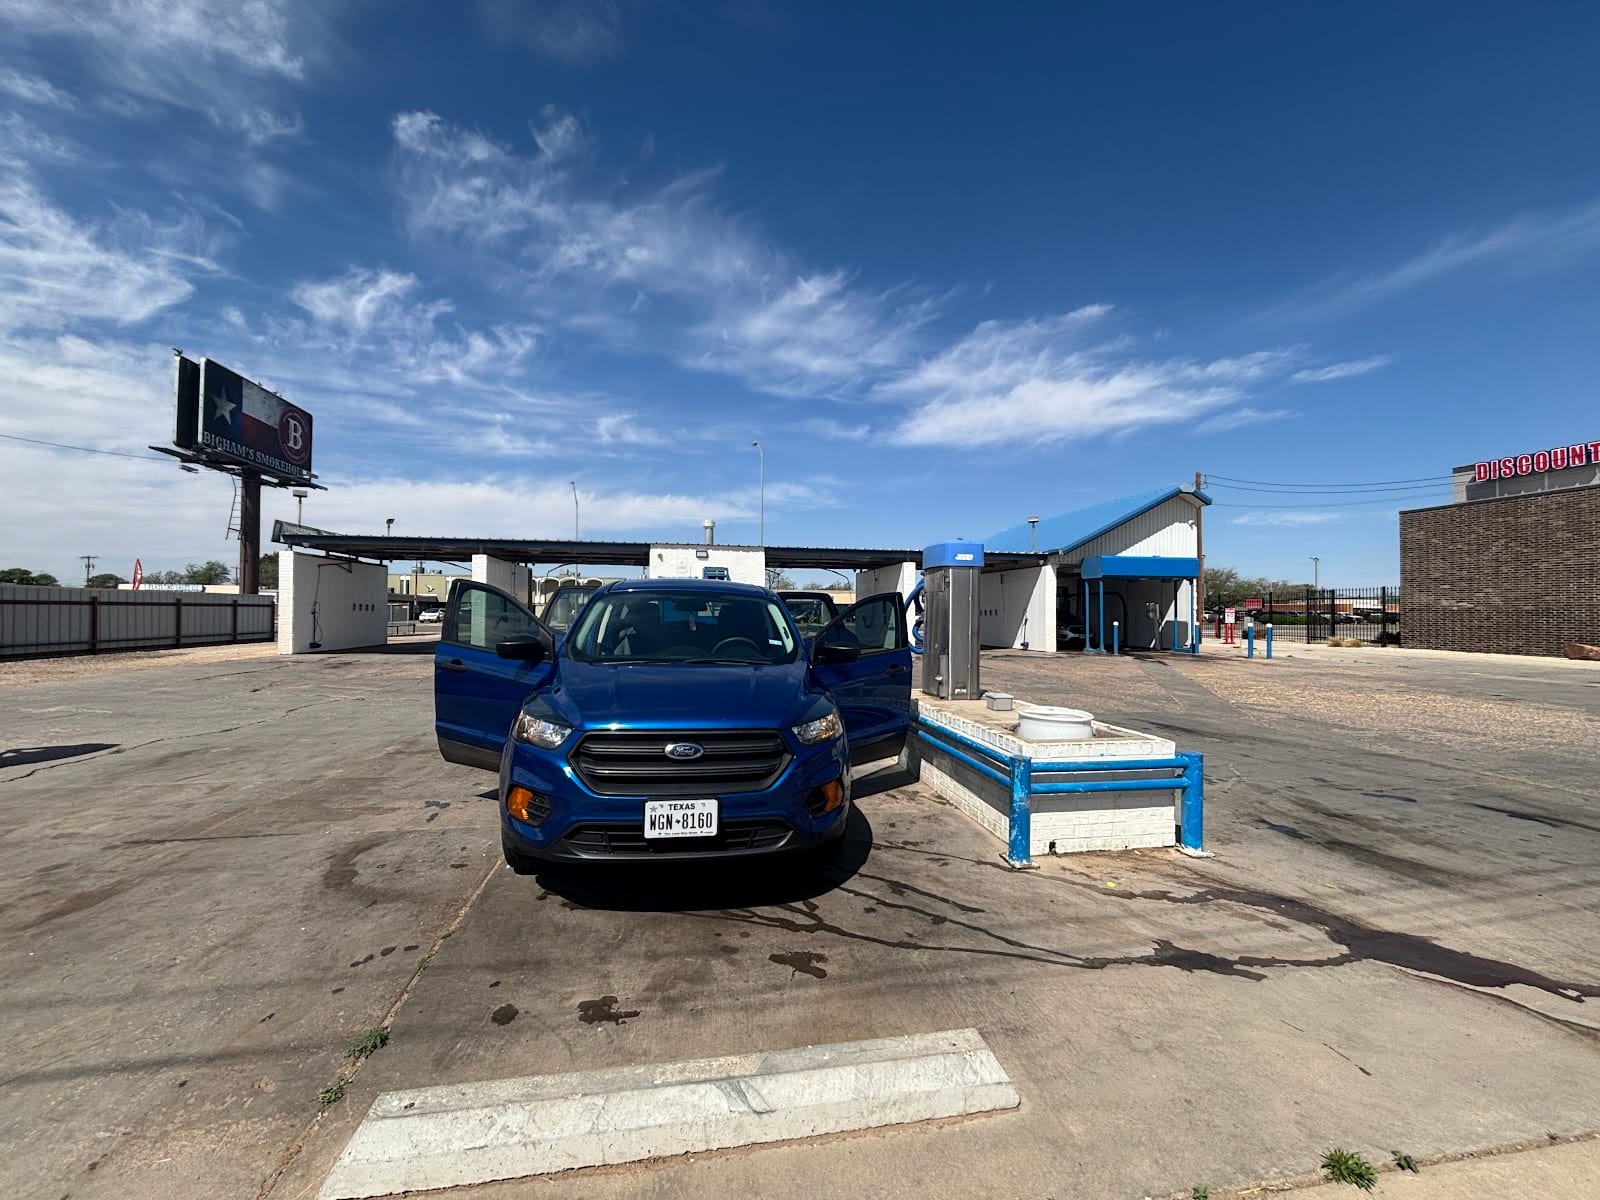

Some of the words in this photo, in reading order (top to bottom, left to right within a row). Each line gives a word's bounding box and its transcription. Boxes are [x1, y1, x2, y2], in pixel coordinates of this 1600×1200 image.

[203, 430, 255, 460] BIGHAM'S
[287, 417, 302, 450] B
[1475, 441, 1600, 482] DISCOUNT
[673, 745, 695, 756] Ford
[667, 802, 696, 811] TEXAS
